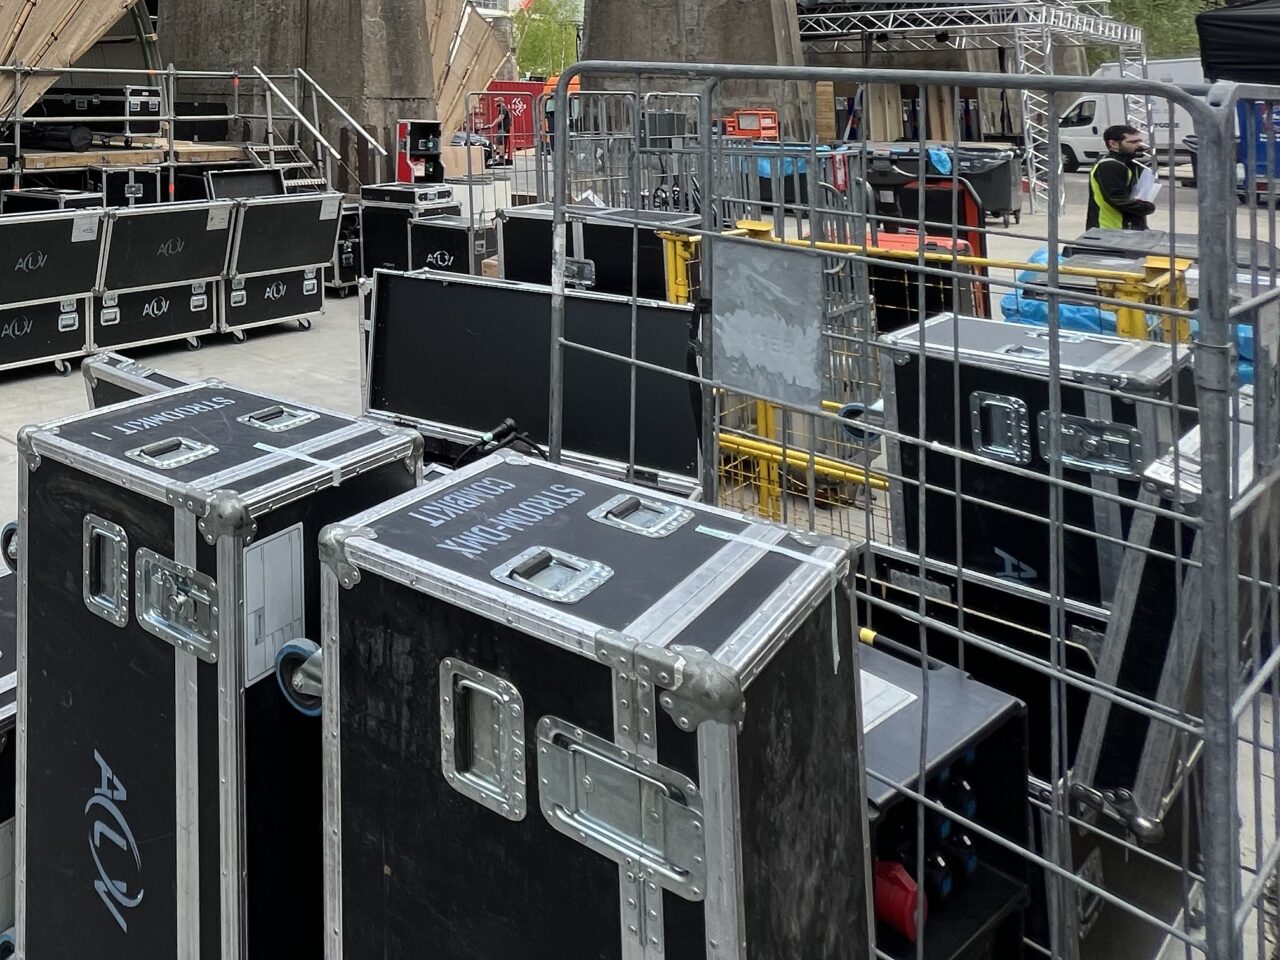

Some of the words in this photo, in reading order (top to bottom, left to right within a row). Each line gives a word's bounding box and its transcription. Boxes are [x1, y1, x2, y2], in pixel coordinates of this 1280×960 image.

[113, 396, 236, 435] STROOMKIT
[408, 476, 516, 528] COMBIKIT
[436, 484, 586, 559] STROOM-DMX
